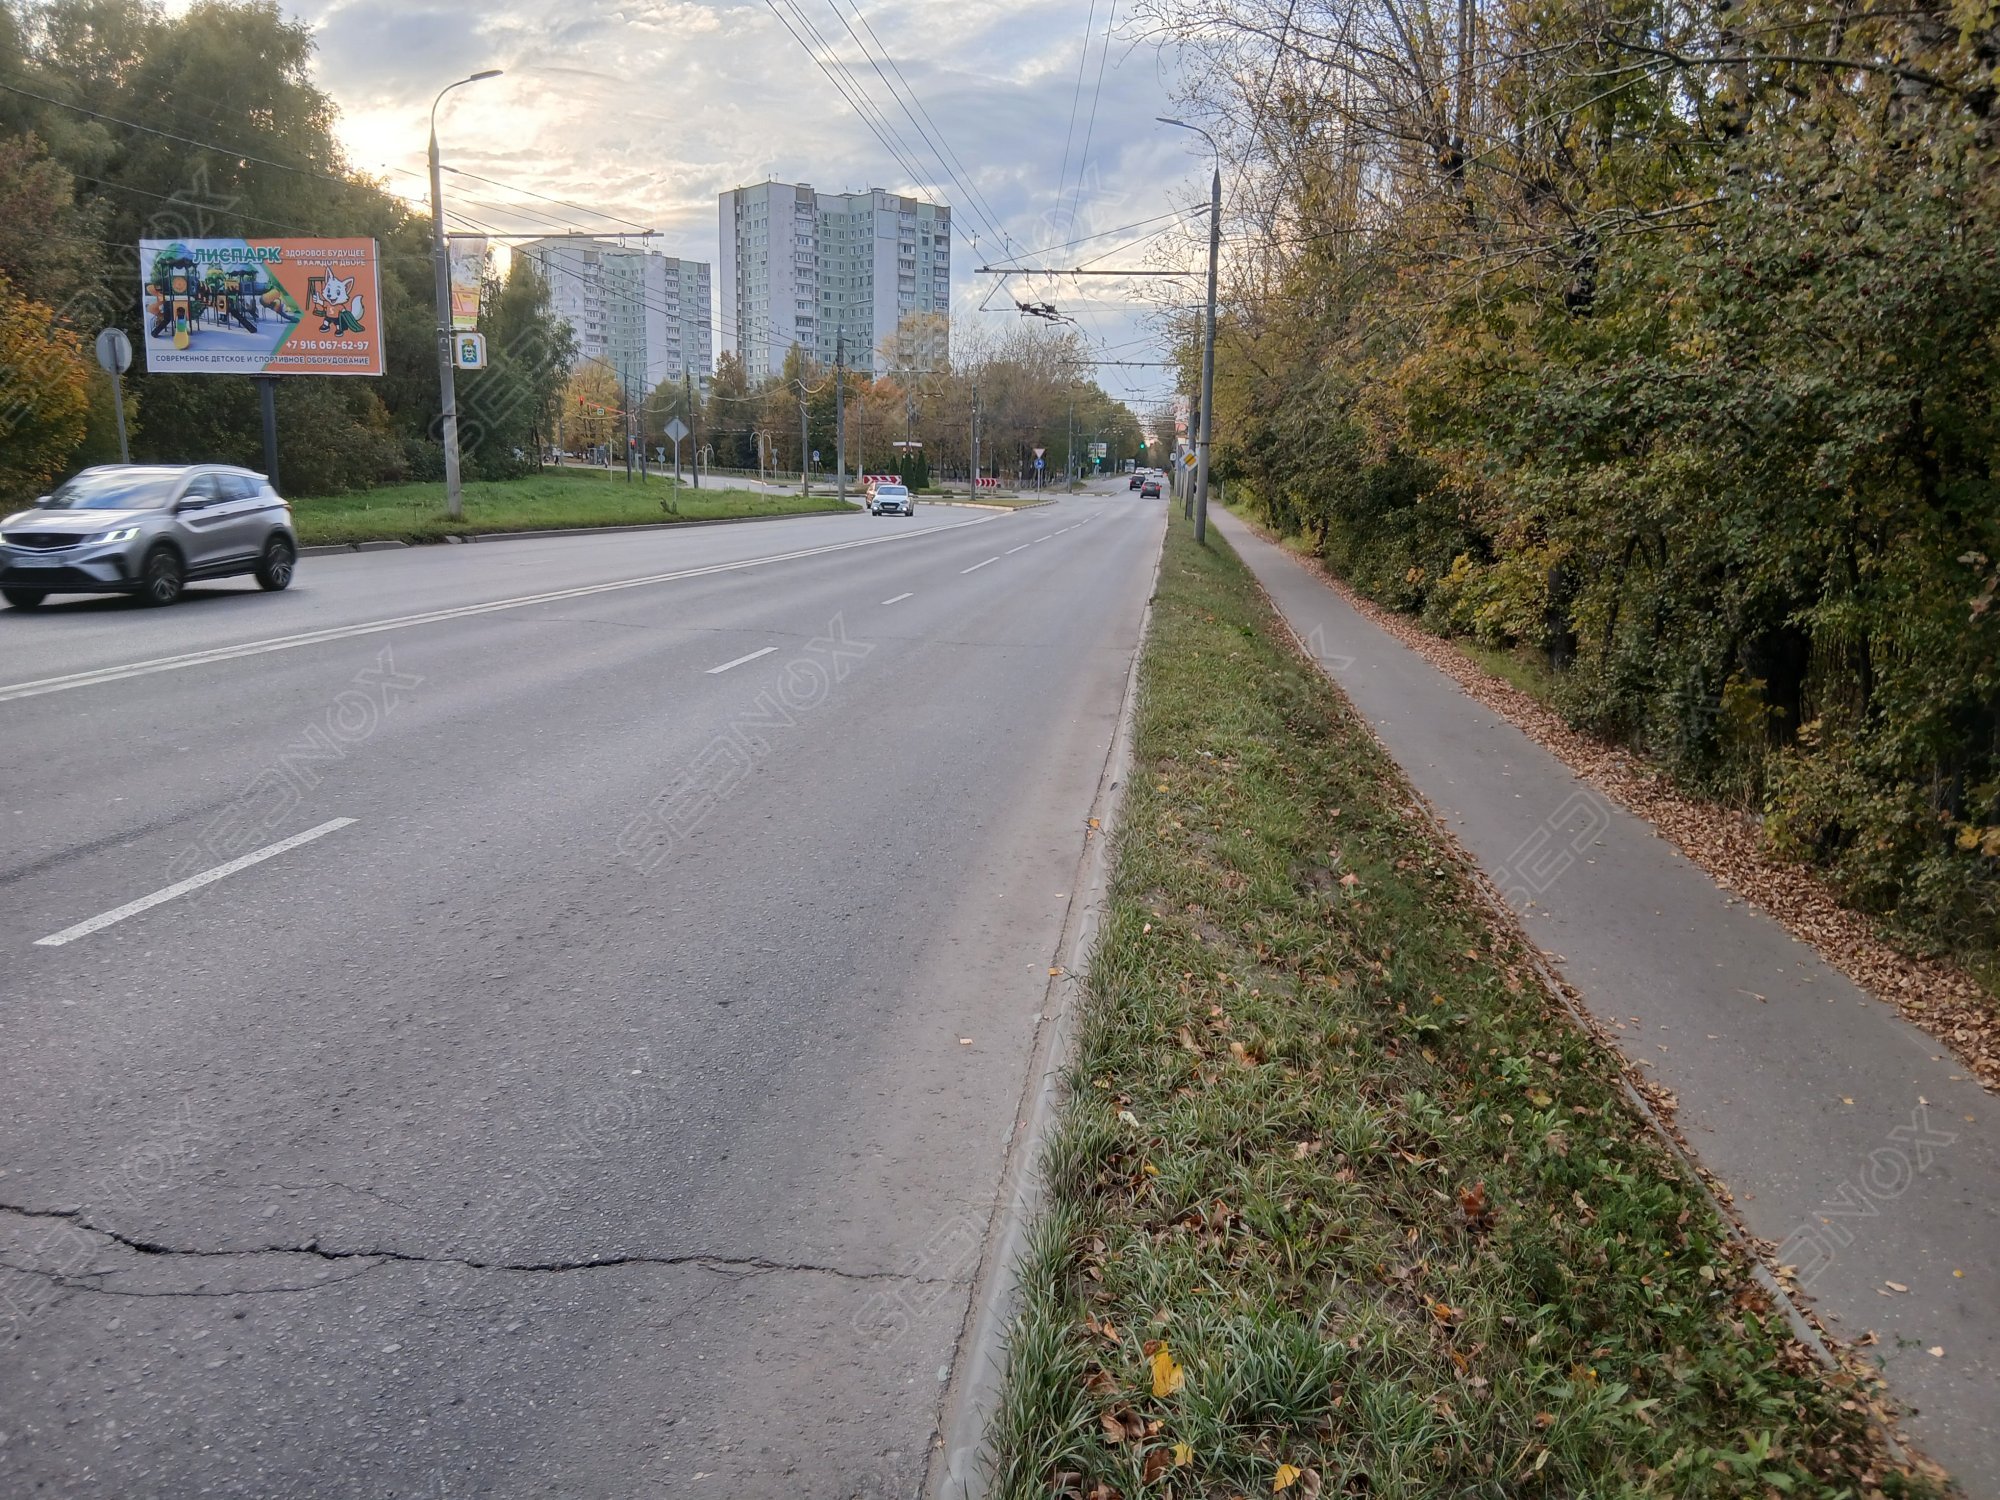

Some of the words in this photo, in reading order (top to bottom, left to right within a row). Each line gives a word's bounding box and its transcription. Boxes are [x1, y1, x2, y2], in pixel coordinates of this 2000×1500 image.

[191, 246, 282, 264] ЛИСПАРК
[285, 249, 326, 258] ЗДОРОВОЕ
[327, 249, 366, 258] БУДУЩЕЕ
[304, 258, 338, 267] КАЖДОМ
[339, 258, 366, 267] ДВОРЕ
[286, 340, 298, 349] +7
[300, 340, 317, 350] 916
[319, 341, 369, 350] 067-62-97
[155, 355, 210, 363] СОВРЕМЕННОЕ
[211, 355, 245, 364] ДЕТСКОЕ
[254, 356, 305, 364] СПОРТИВНОЕ
[306, 356, 370, 365] ОБОРУДОВАНИЕ
